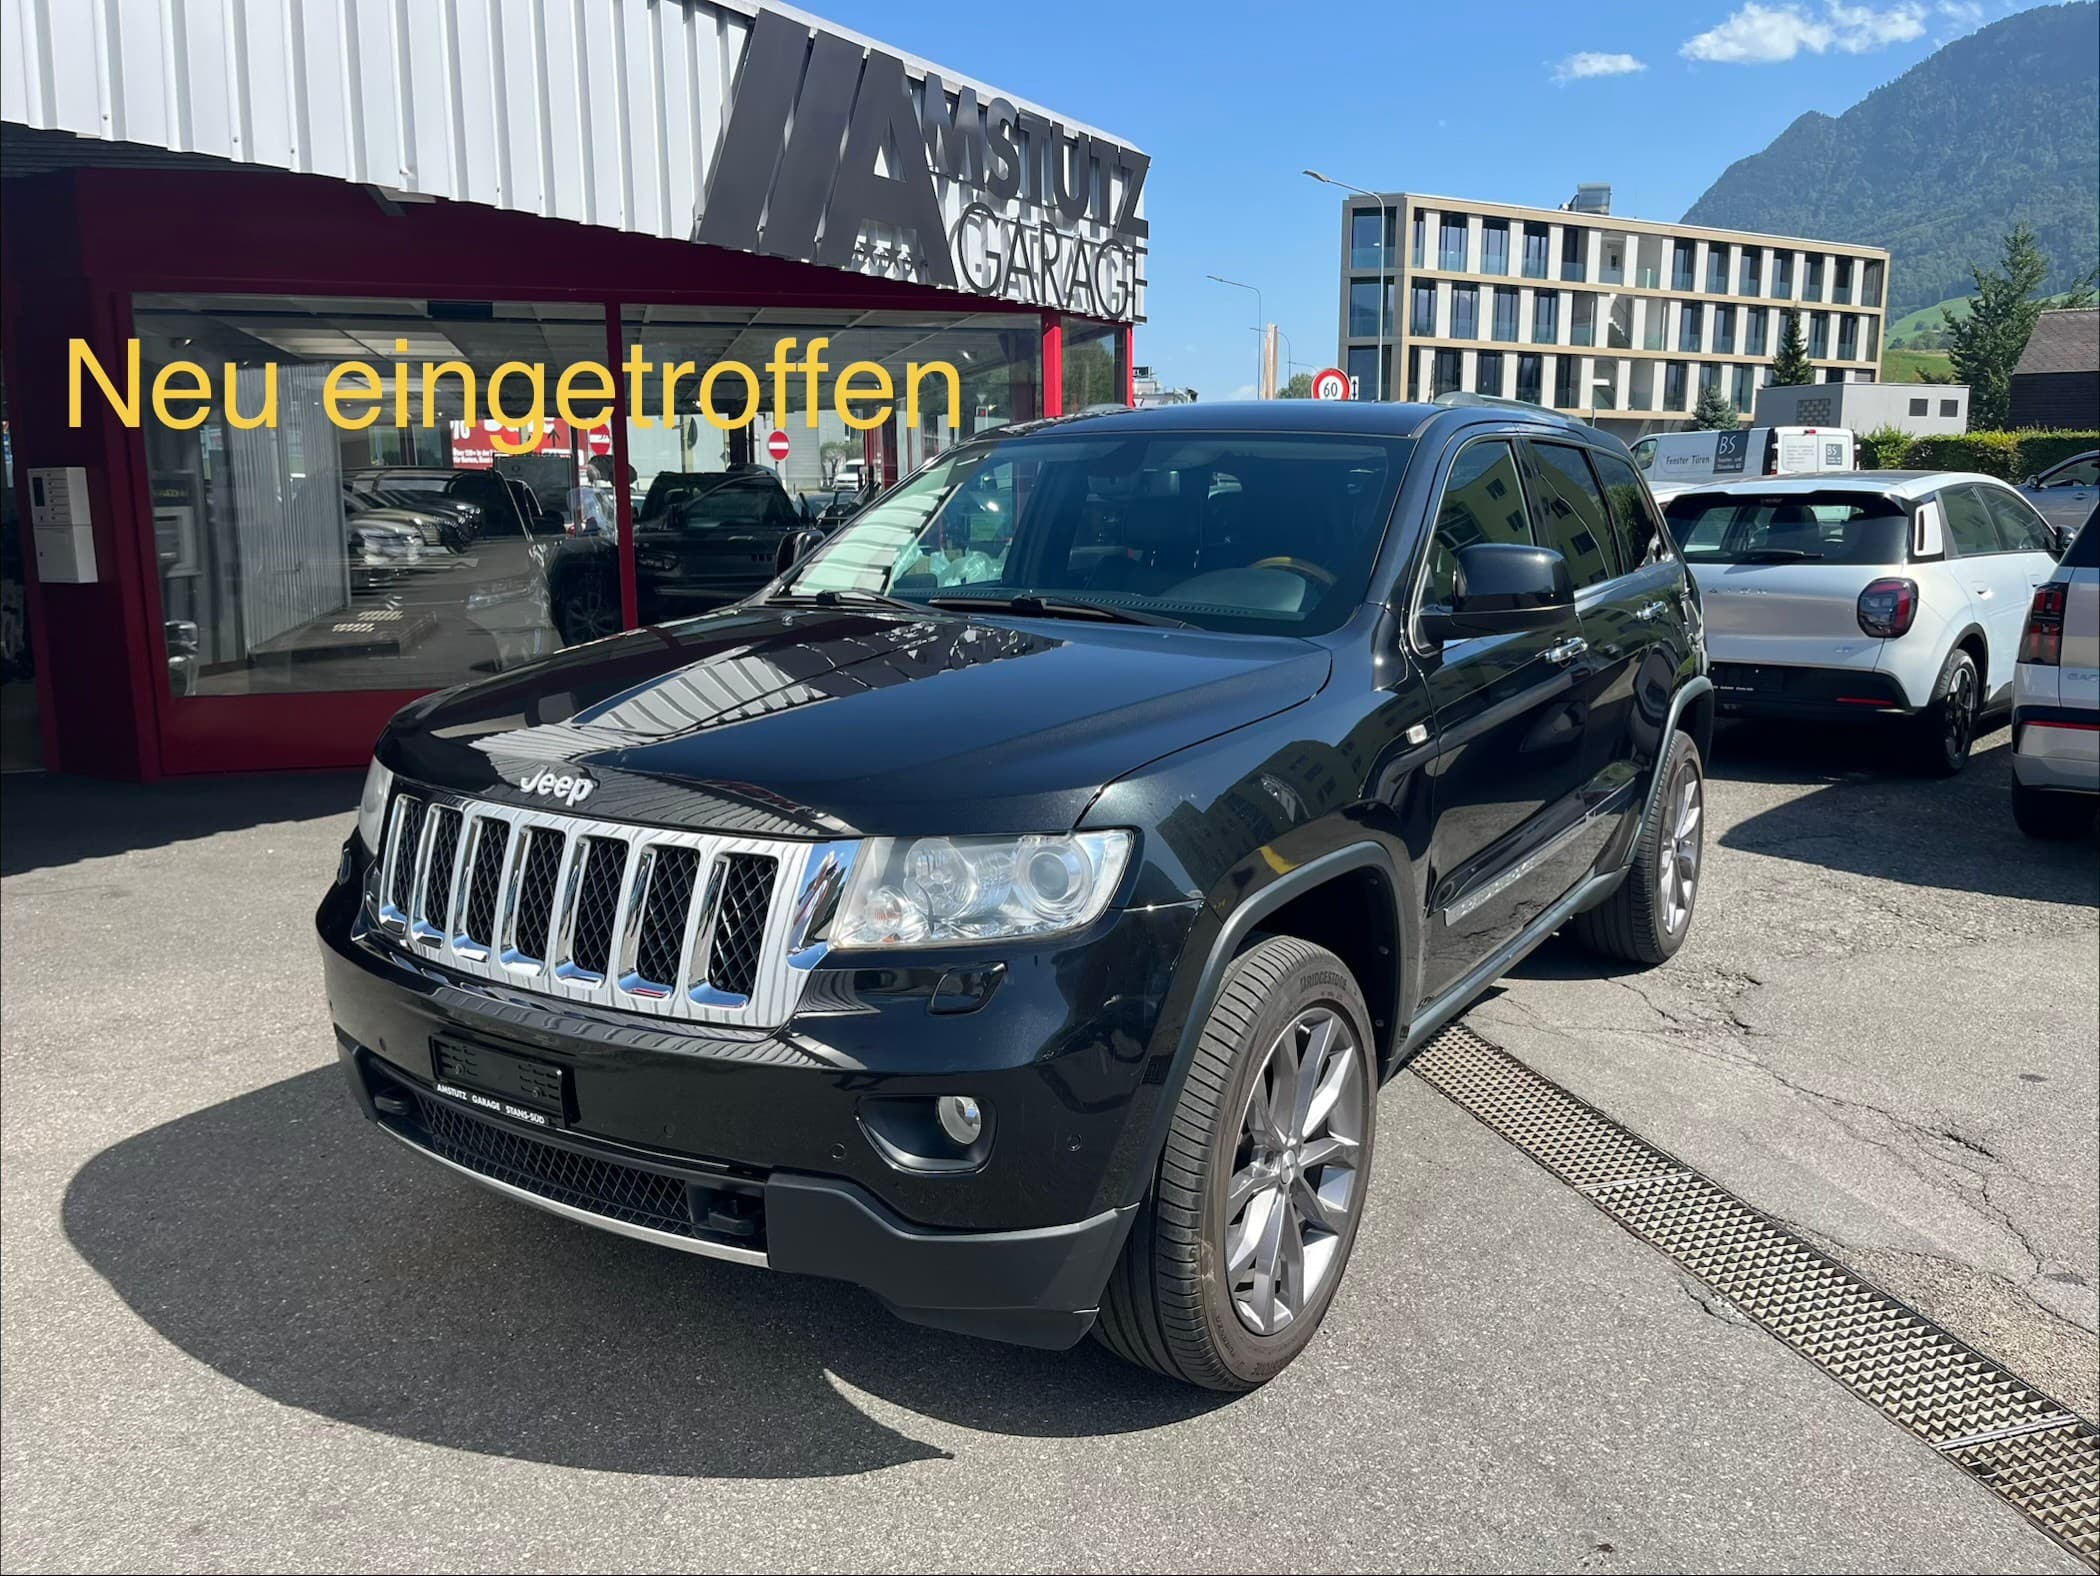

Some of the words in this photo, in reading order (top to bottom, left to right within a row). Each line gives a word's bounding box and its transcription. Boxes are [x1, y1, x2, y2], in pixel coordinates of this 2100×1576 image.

[815, 46, 1152, 289] AMSTUTZ
[956, 201, 1148, 324] GARAGE
[1323, 382, 1338, 397] 60
[1718, 435, 1737, 455] BS
[1665, 455, 1689, 465] Fenster
[519, 763, 594, 808] Jeep
[437, 1084, 467, 1100] AMSTUTZ
[472, 1095, 500, 1111] GARAGE
